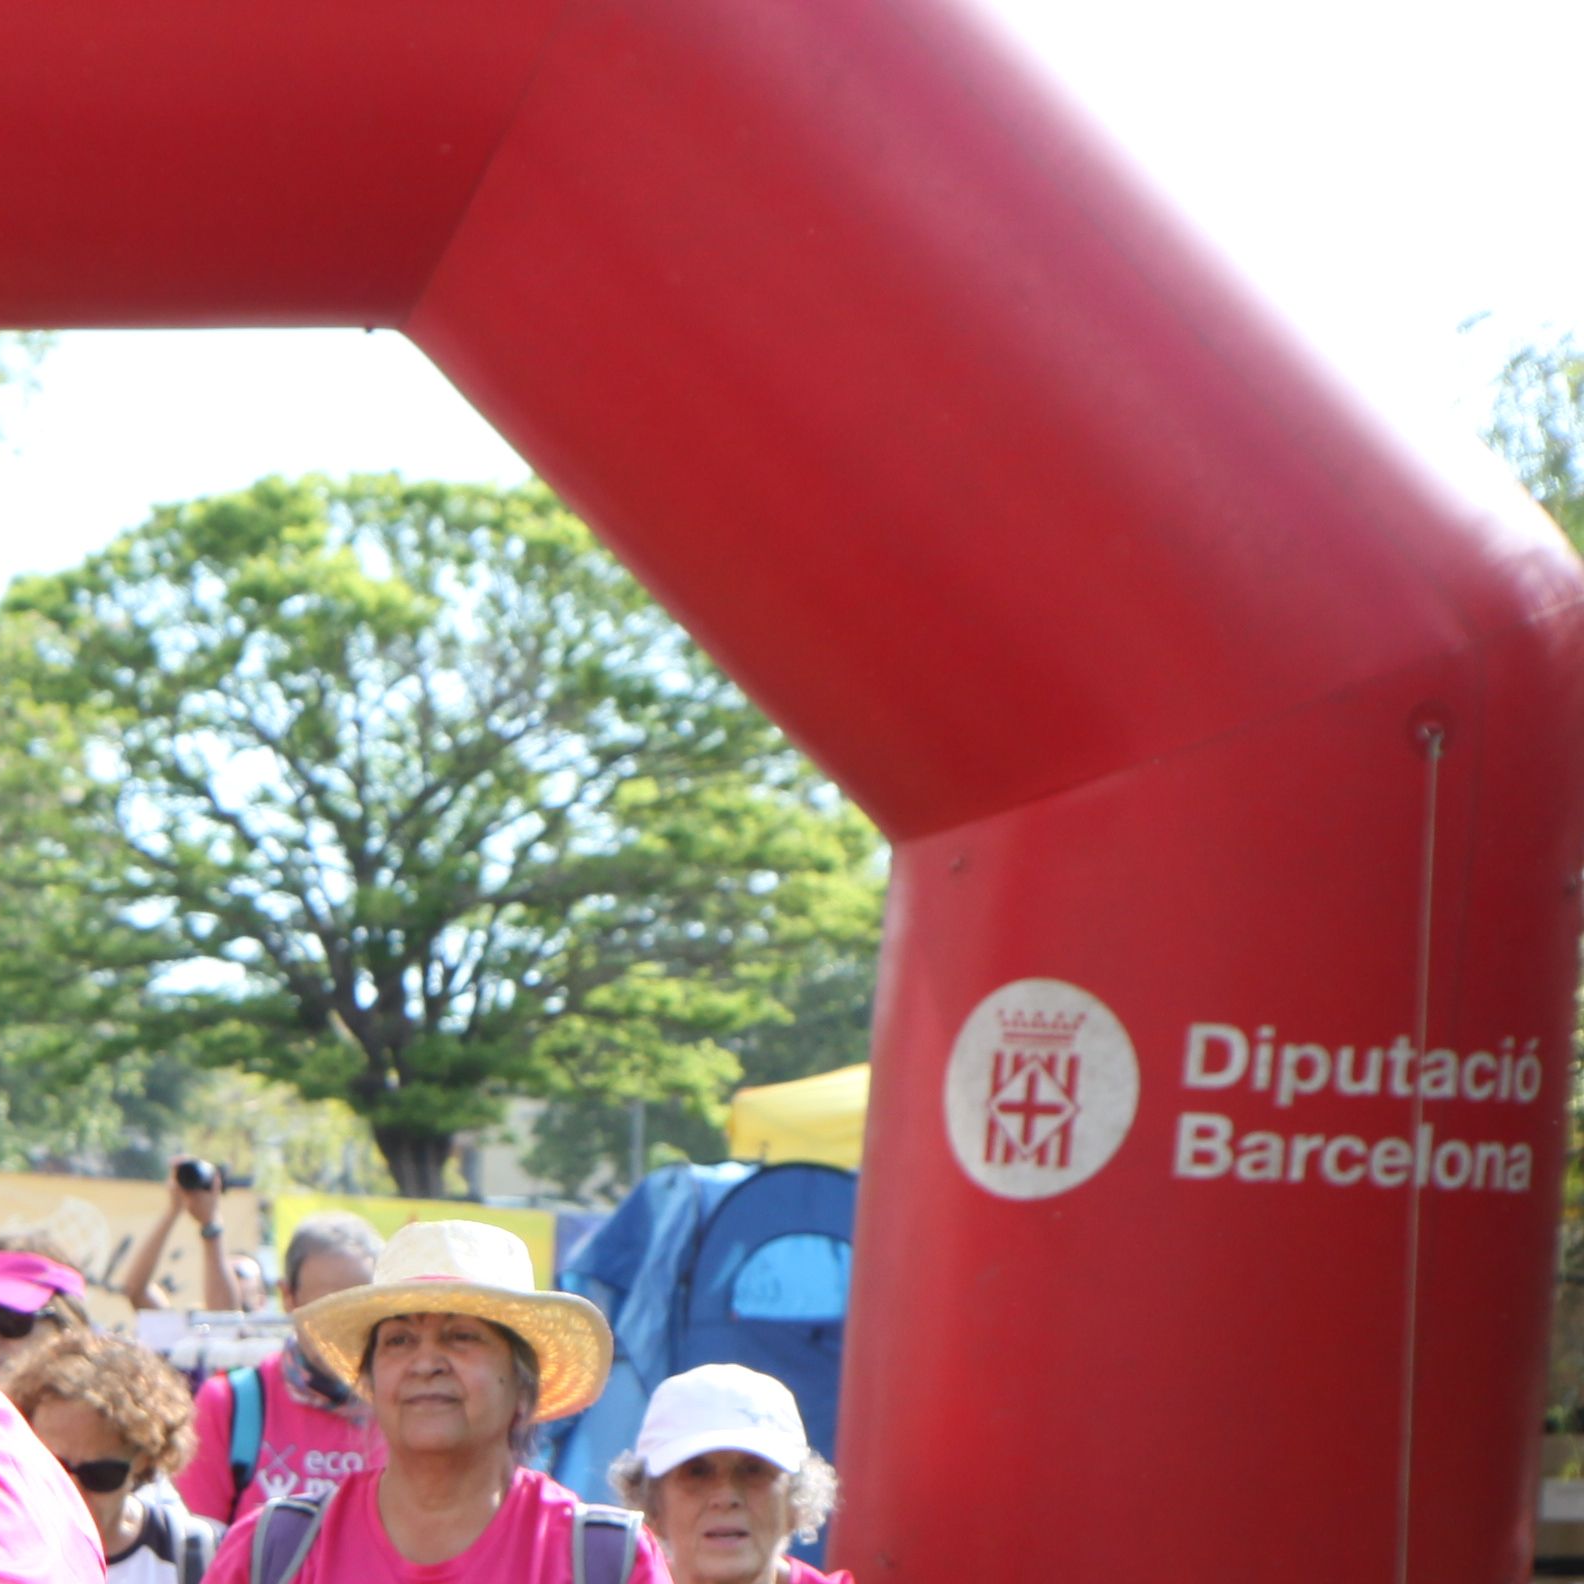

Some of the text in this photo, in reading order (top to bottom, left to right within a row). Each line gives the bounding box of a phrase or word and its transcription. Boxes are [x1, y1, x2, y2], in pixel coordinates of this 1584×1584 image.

[1182, 1022, 1542, 1106] Diputació
[1173, 1112, 1532, 1191] Barcelona
[303, 1450, 364, 1475] eco
